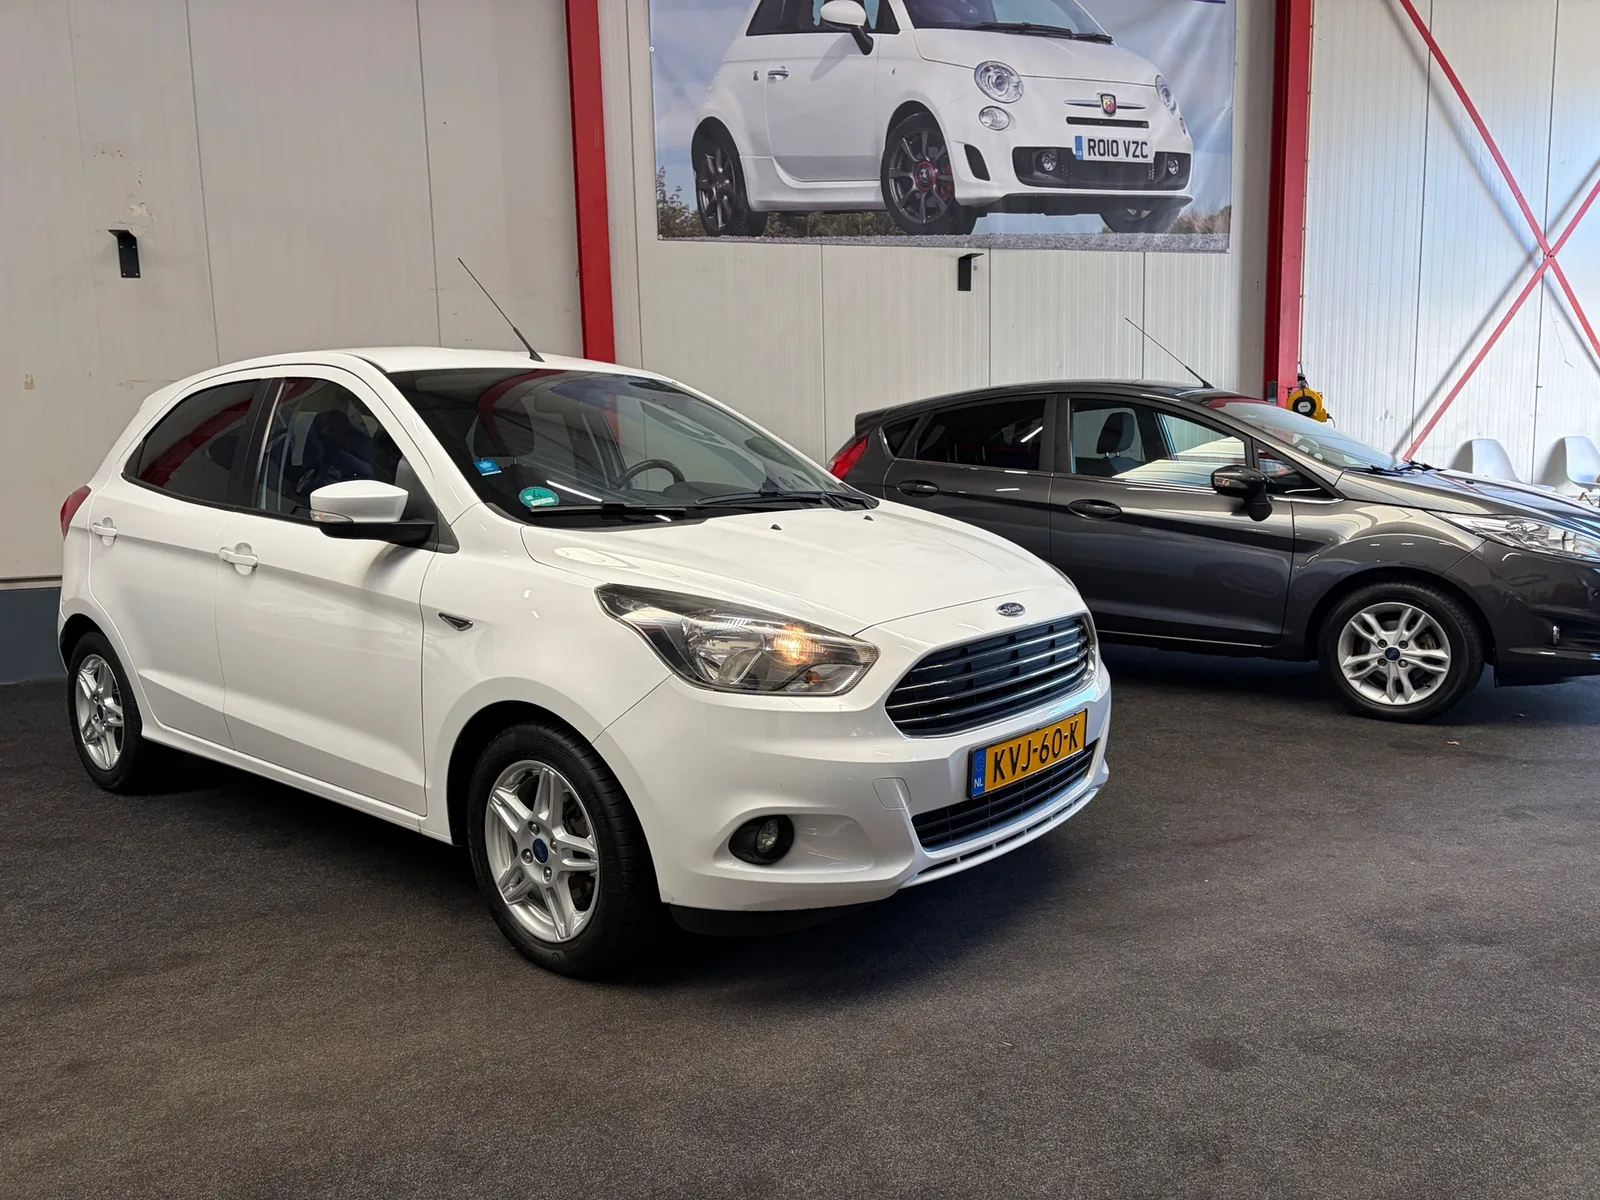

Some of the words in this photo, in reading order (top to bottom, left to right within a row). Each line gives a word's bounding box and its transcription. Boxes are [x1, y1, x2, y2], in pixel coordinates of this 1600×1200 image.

[1087, 138, 1119, 157] RO10
[1123, 140, 1148, 159] VZC
[993, 719, 1079, 783] KVJ-60-K
[973, 777, 984, 788] NL
